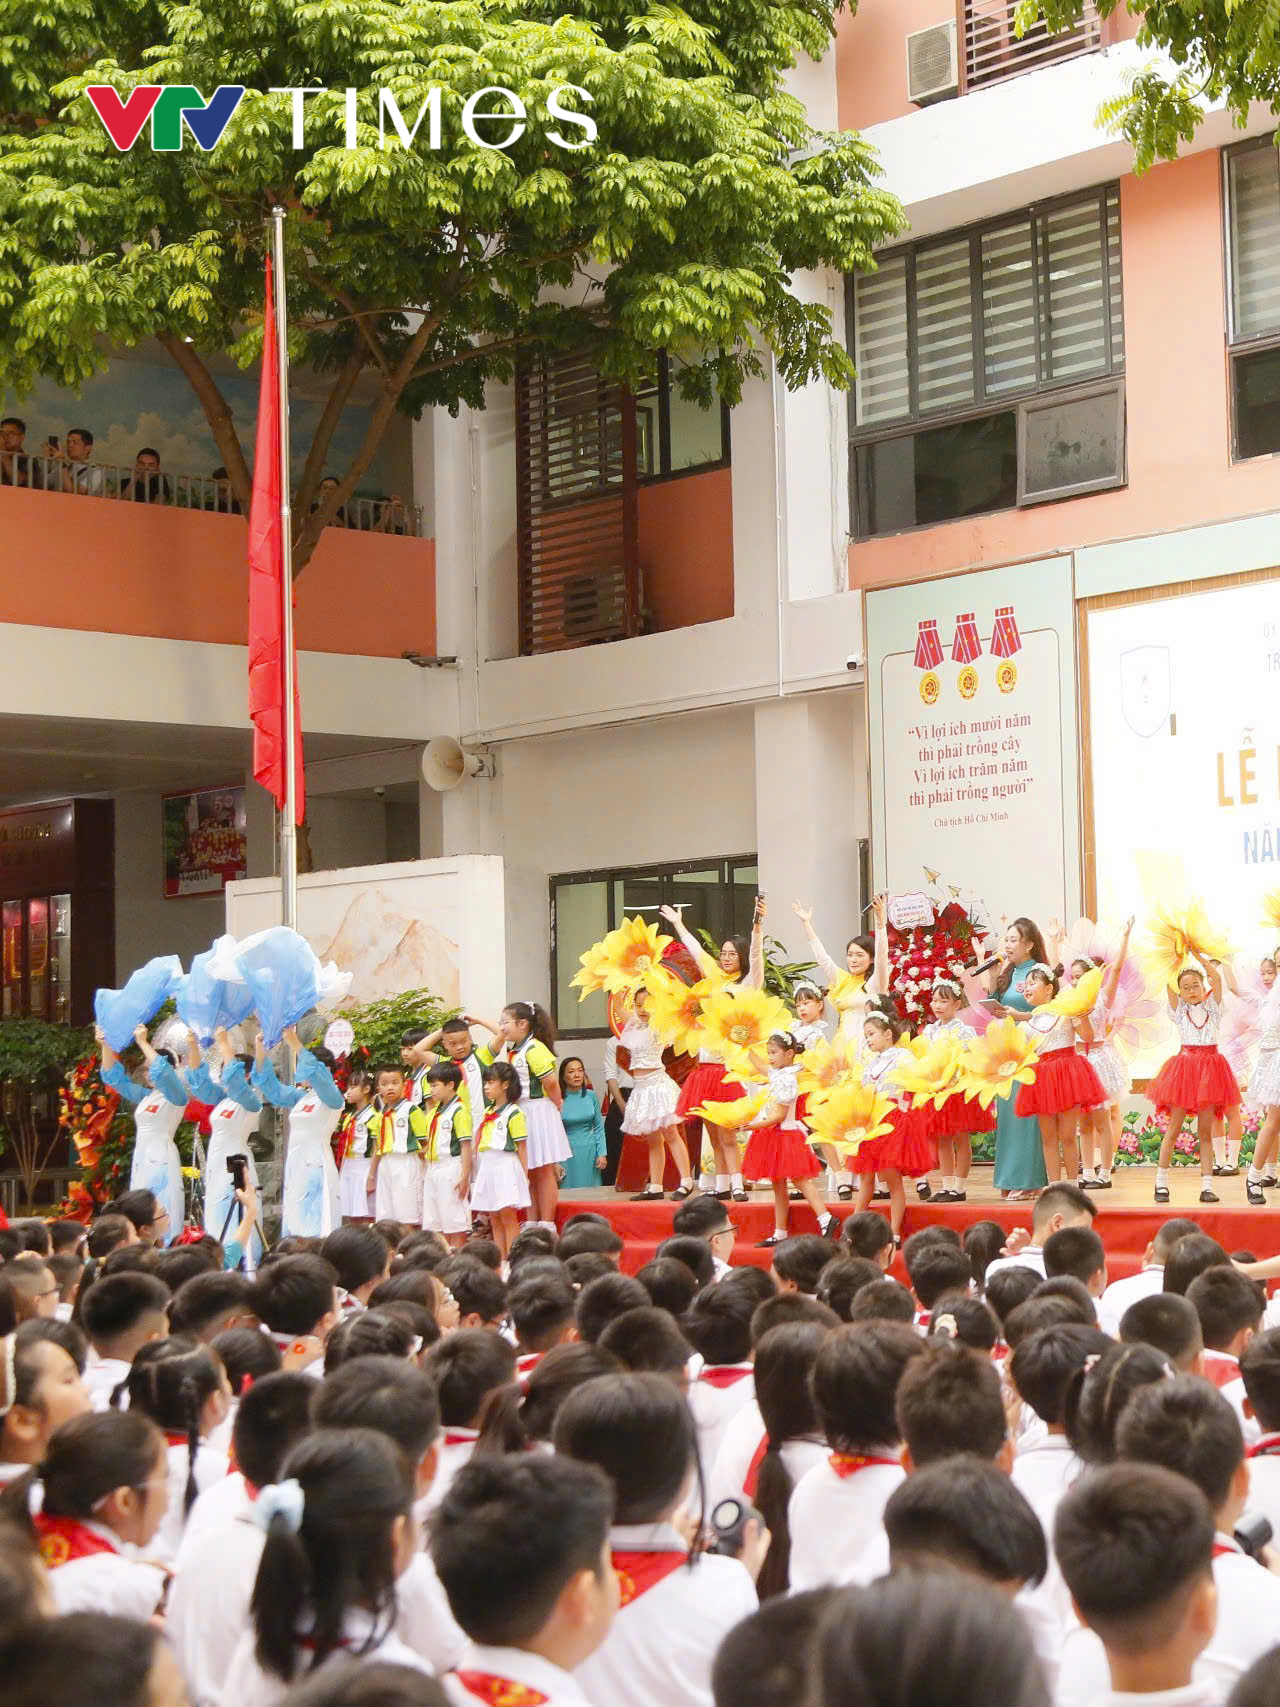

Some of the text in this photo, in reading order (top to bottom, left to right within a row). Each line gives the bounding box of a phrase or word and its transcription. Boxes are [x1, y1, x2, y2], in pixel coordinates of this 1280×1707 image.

[908, 713, 1031, 741] “Vì lợi ích mười năm
[919, 735, 1021, 763] thì phải trồng cây
[914, 758, 1027, 785] Vì lợi ích trăm năm
[1216, 727, 1258, 808] LỄ
[909, 777, 1034, 808] thì phải trồng người”
[934, 811, 1009, 828] Chủ tịch Hồ Chí Minh
